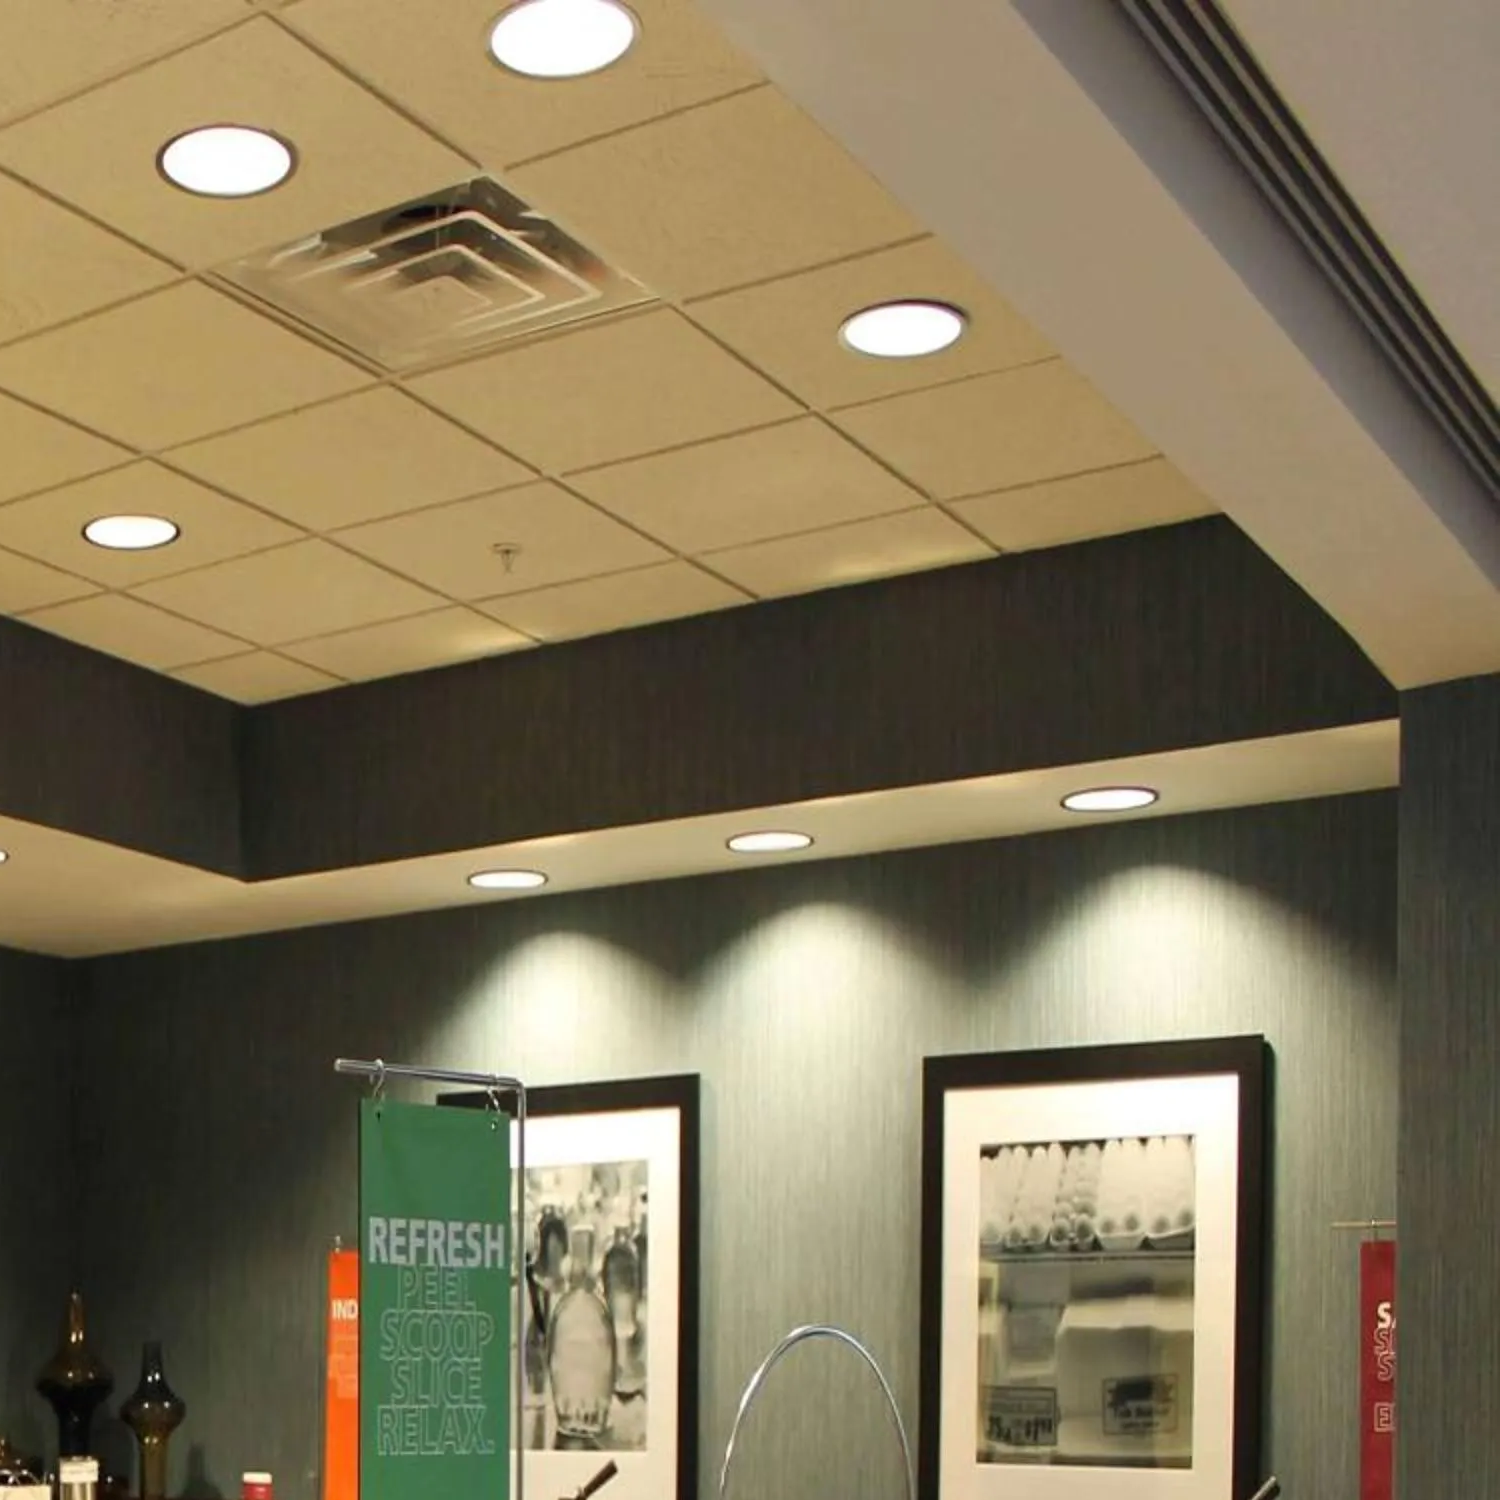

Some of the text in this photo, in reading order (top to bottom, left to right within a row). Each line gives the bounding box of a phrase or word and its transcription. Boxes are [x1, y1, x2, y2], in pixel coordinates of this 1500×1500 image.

[368, 1216, 505, 1270] REFRESH
[397, 1264, 478, 1311] PEEL
[380, 1308, 496, 1361] SCOOP
[389, 1357, 483, 1408] SLICE
[377, 1404, 496, 1456] RELAX.
